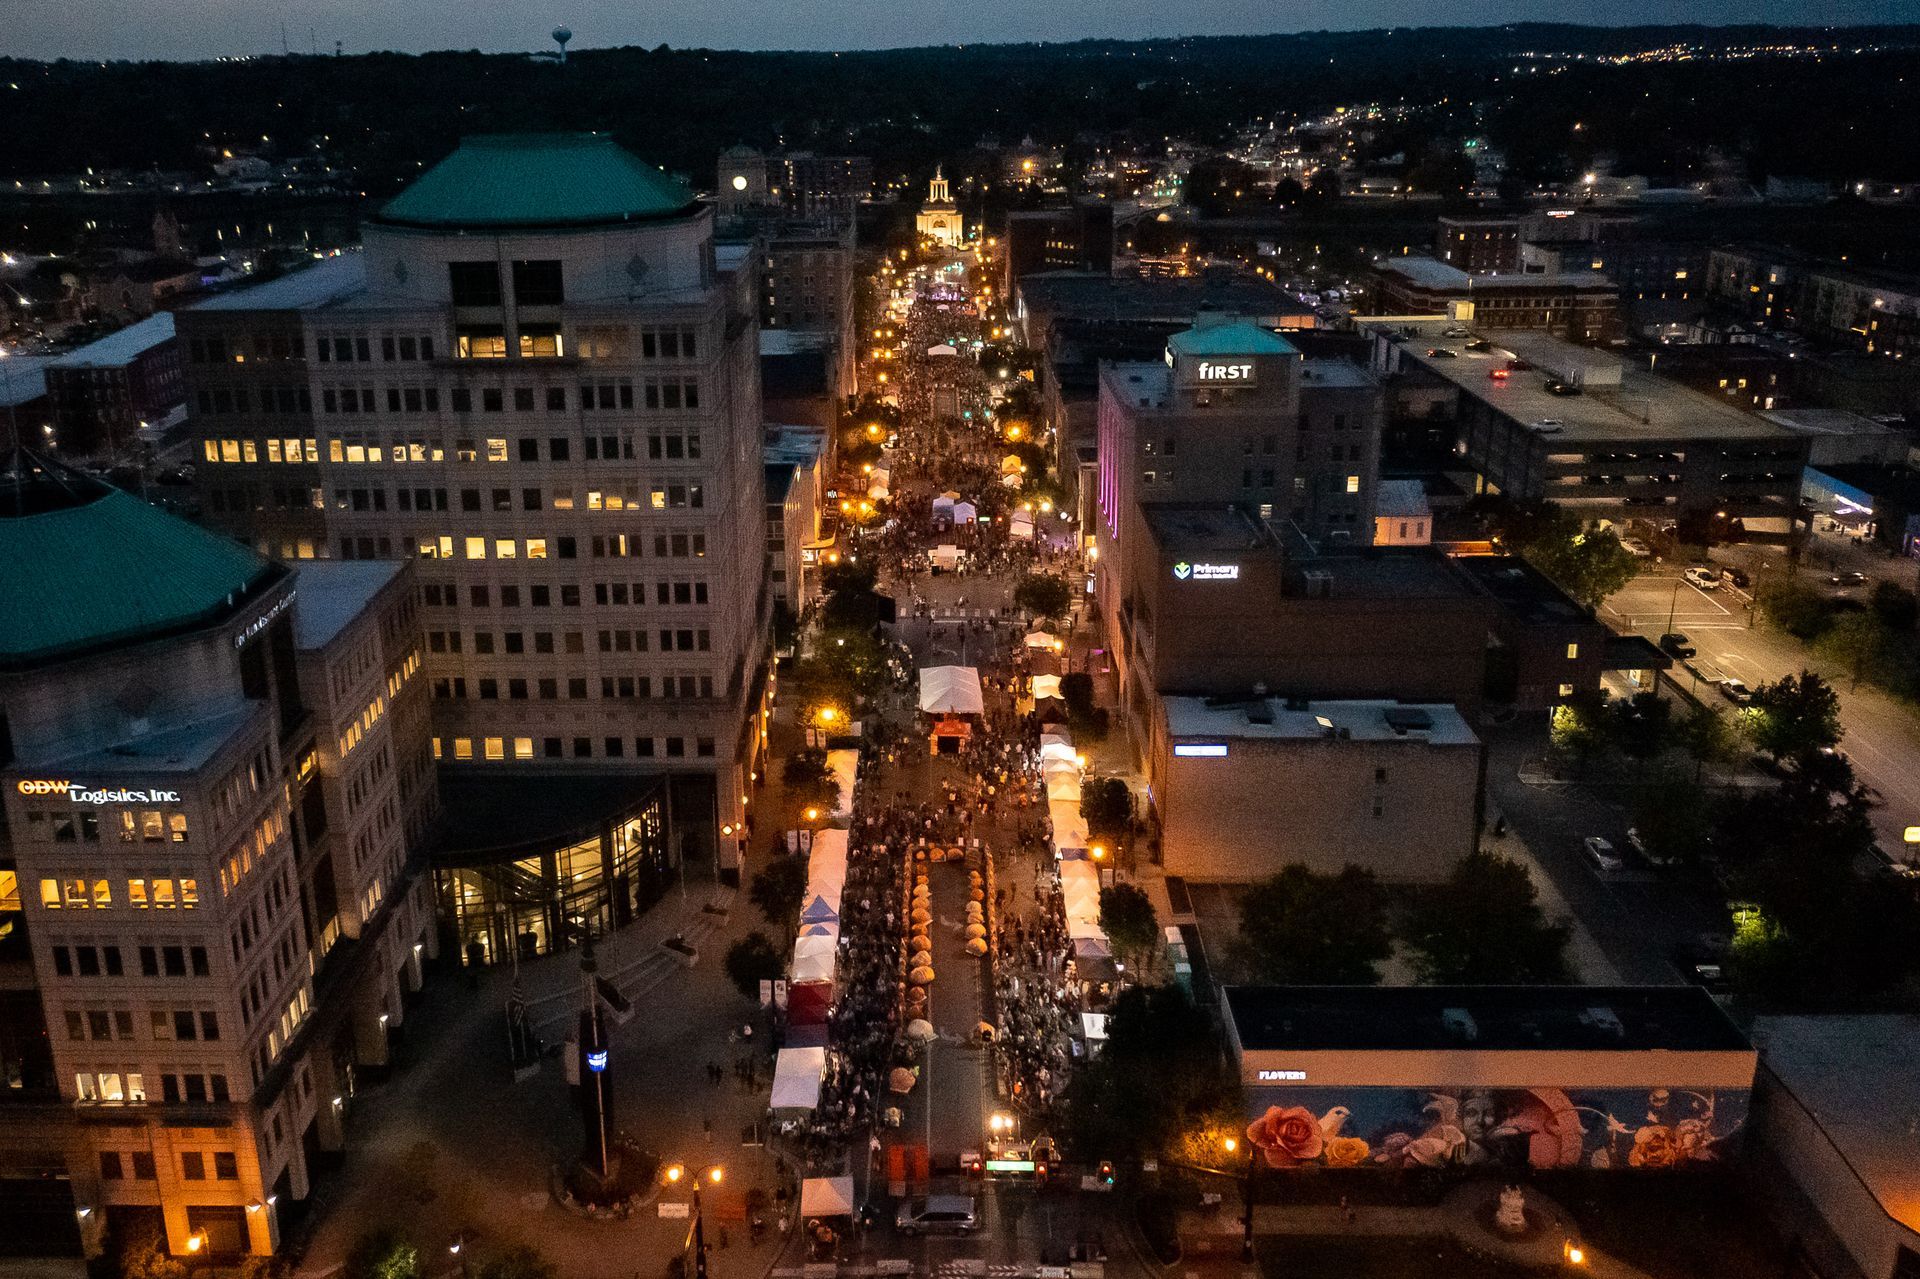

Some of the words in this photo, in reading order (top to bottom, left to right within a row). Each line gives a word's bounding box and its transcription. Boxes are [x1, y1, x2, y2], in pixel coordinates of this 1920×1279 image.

[1193, 563, 1239, 577] Primary
[17, 780, 70, 795] ODW
[151, 789, 181, 802] Inc.
[1259, 1070, 1306, 1080] FLOWERS
